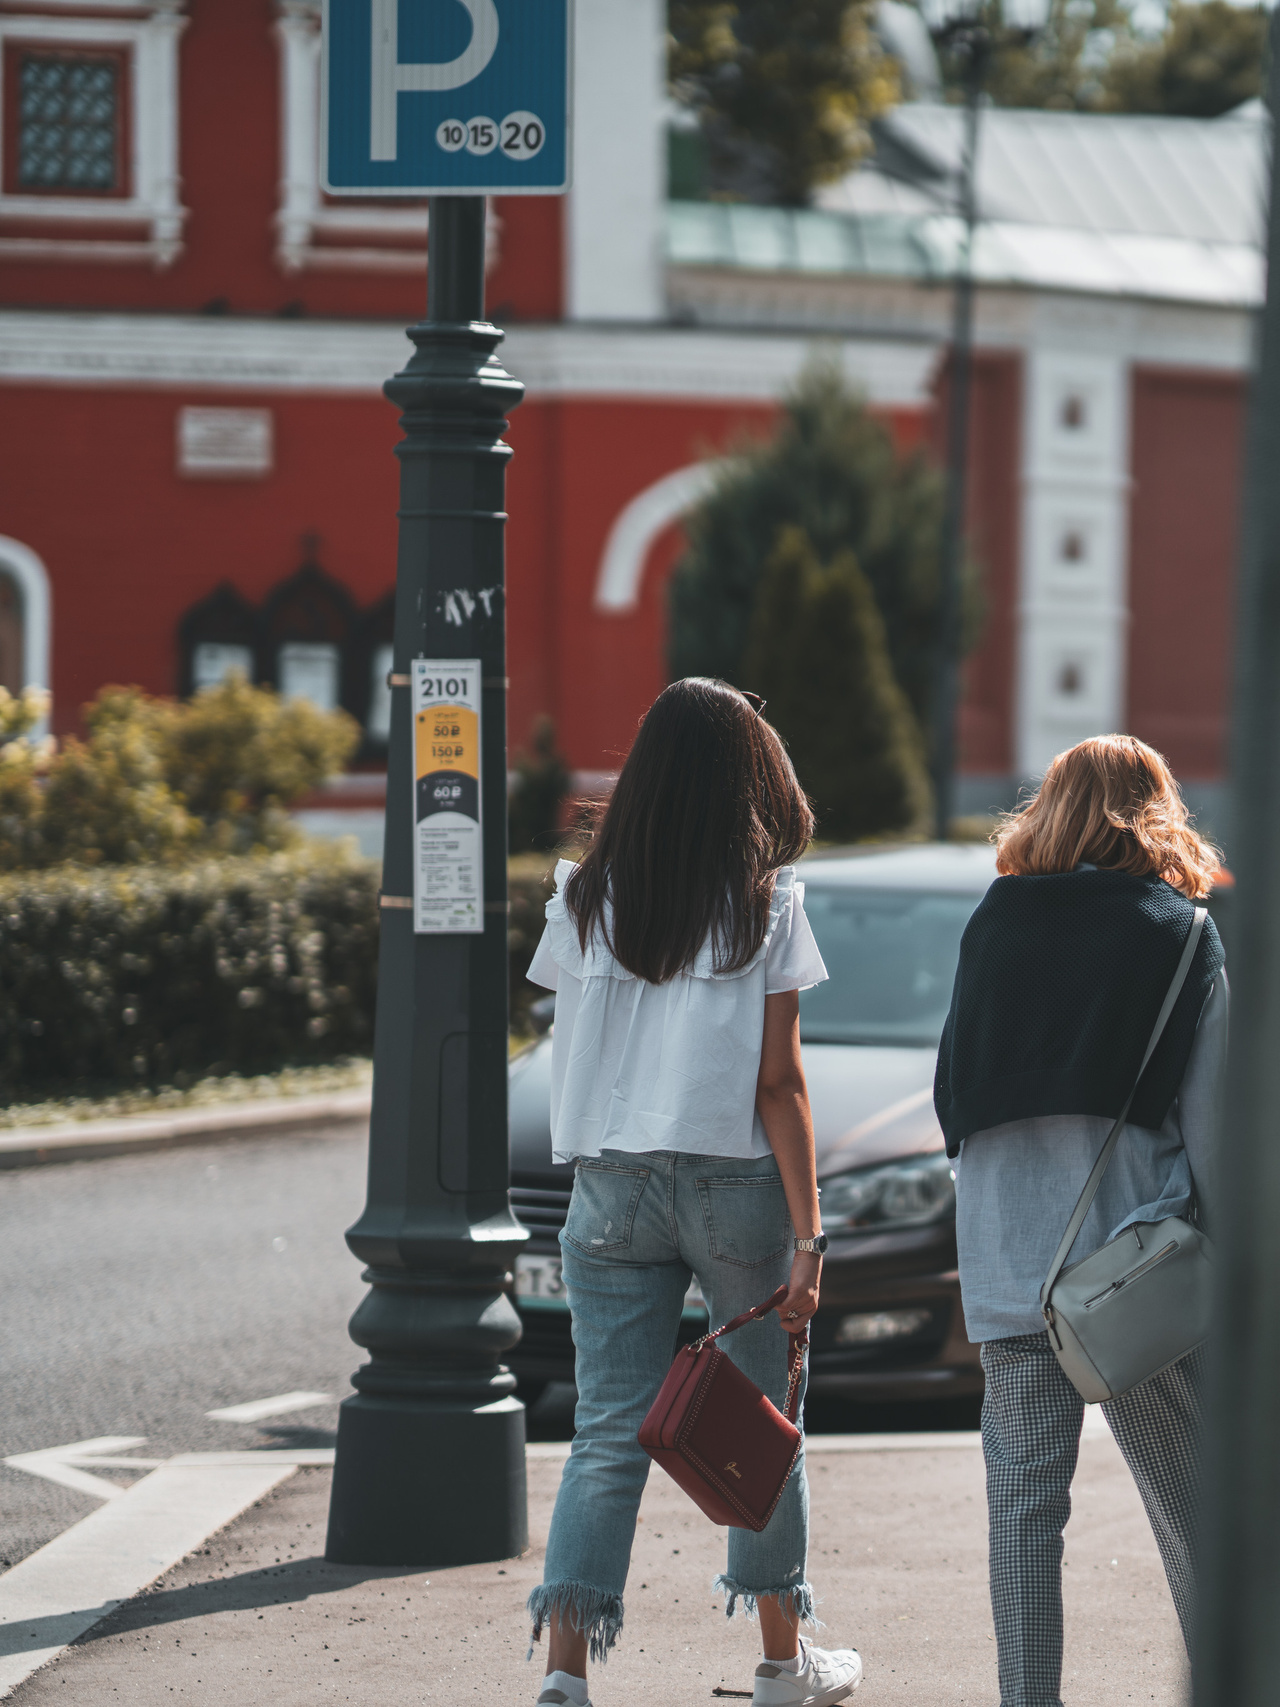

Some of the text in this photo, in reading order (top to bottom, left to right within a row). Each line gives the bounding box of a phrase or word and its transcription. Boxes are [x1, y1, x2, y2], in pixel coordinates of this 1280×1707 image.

[370, 0, 500, 161] P
[442, 121, 542, 151] 10 15 20
[421, 677, 468, 697] 2101
[434, 725, 450, 737] 50
[432, 745, 453, 757] 150
[433, 785, 450, 798] 60
